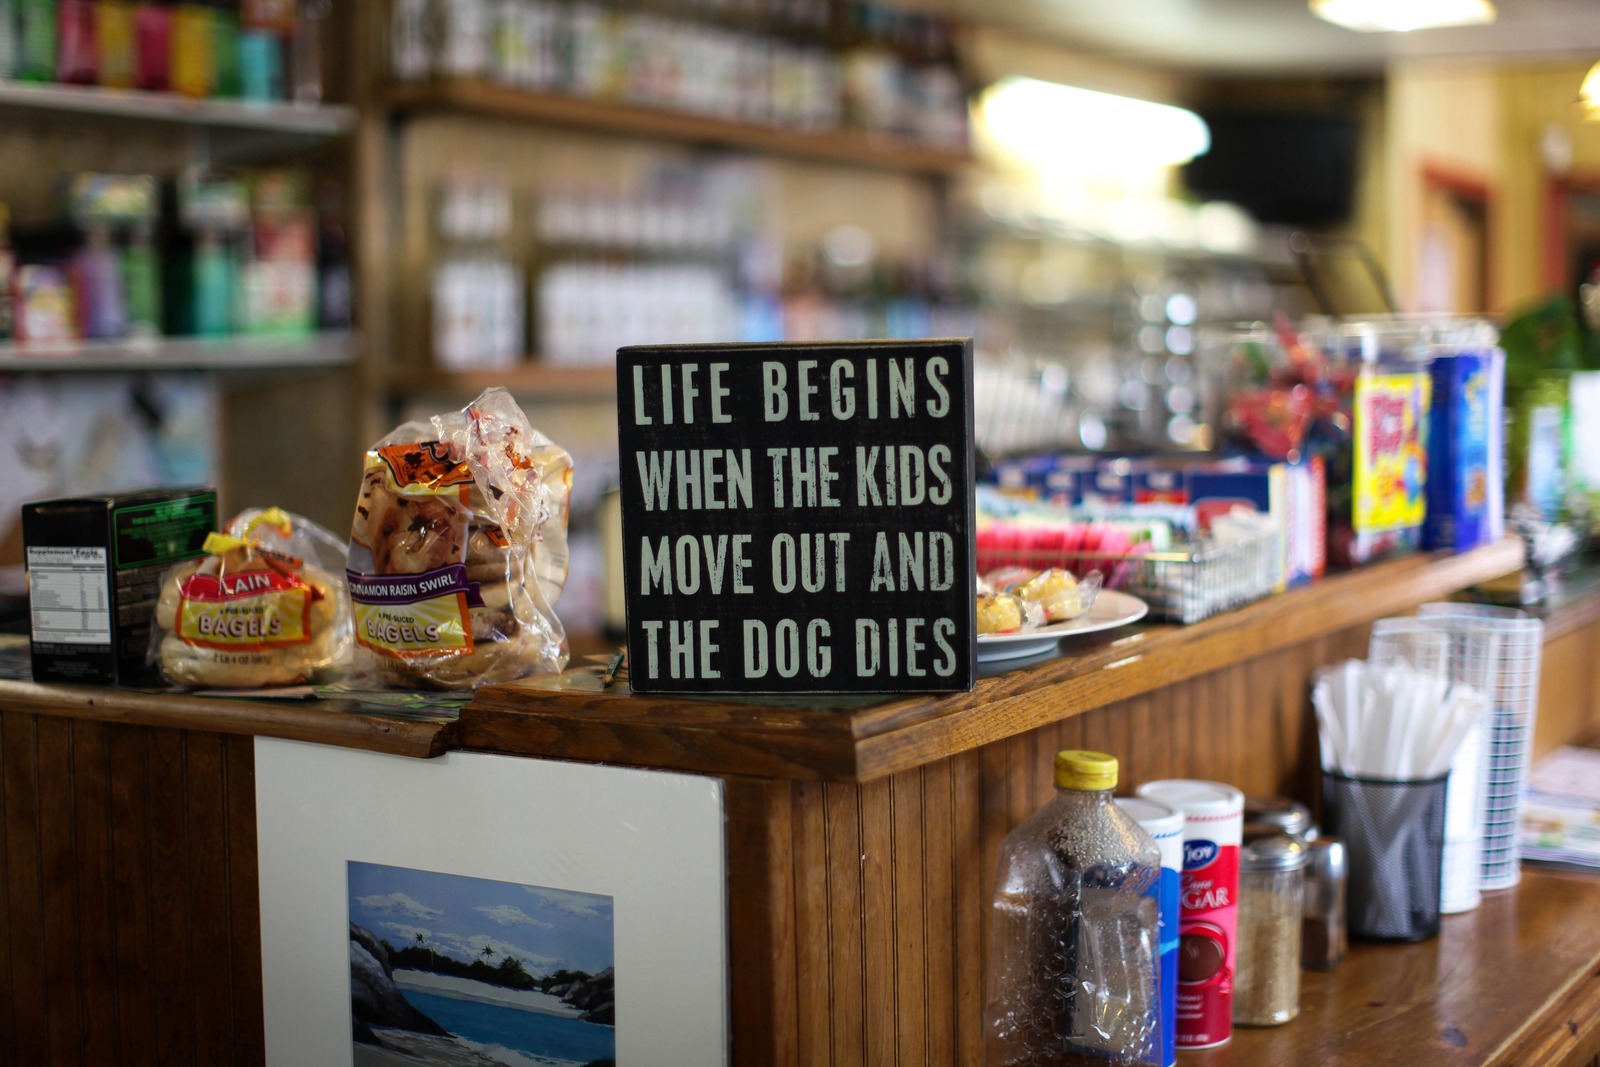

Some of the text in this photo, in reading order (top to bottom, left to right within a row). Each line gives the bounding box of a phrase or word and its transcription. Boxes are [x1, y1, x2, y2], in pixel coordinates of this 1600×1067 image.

[633, 357, 949, 425] LIFE BEGINS
[636, 444, 952, 511] WHEN THE KIDS
[641, 531, 954, 595] MOVE OUT AND
[220, 574, 271, 596] LAIN
[349, 573, 456, 597] CINNAMON RAISIN SWIRL
[200, 614, 282, 637] BAGELS
[383, 612, 415, 624] PRE-SLICED
[367, 618, 440, 643] BAGELS
[642, 617, 957, 679] THE DOG DIES
[1182, 886, 1229, 910] GAR
